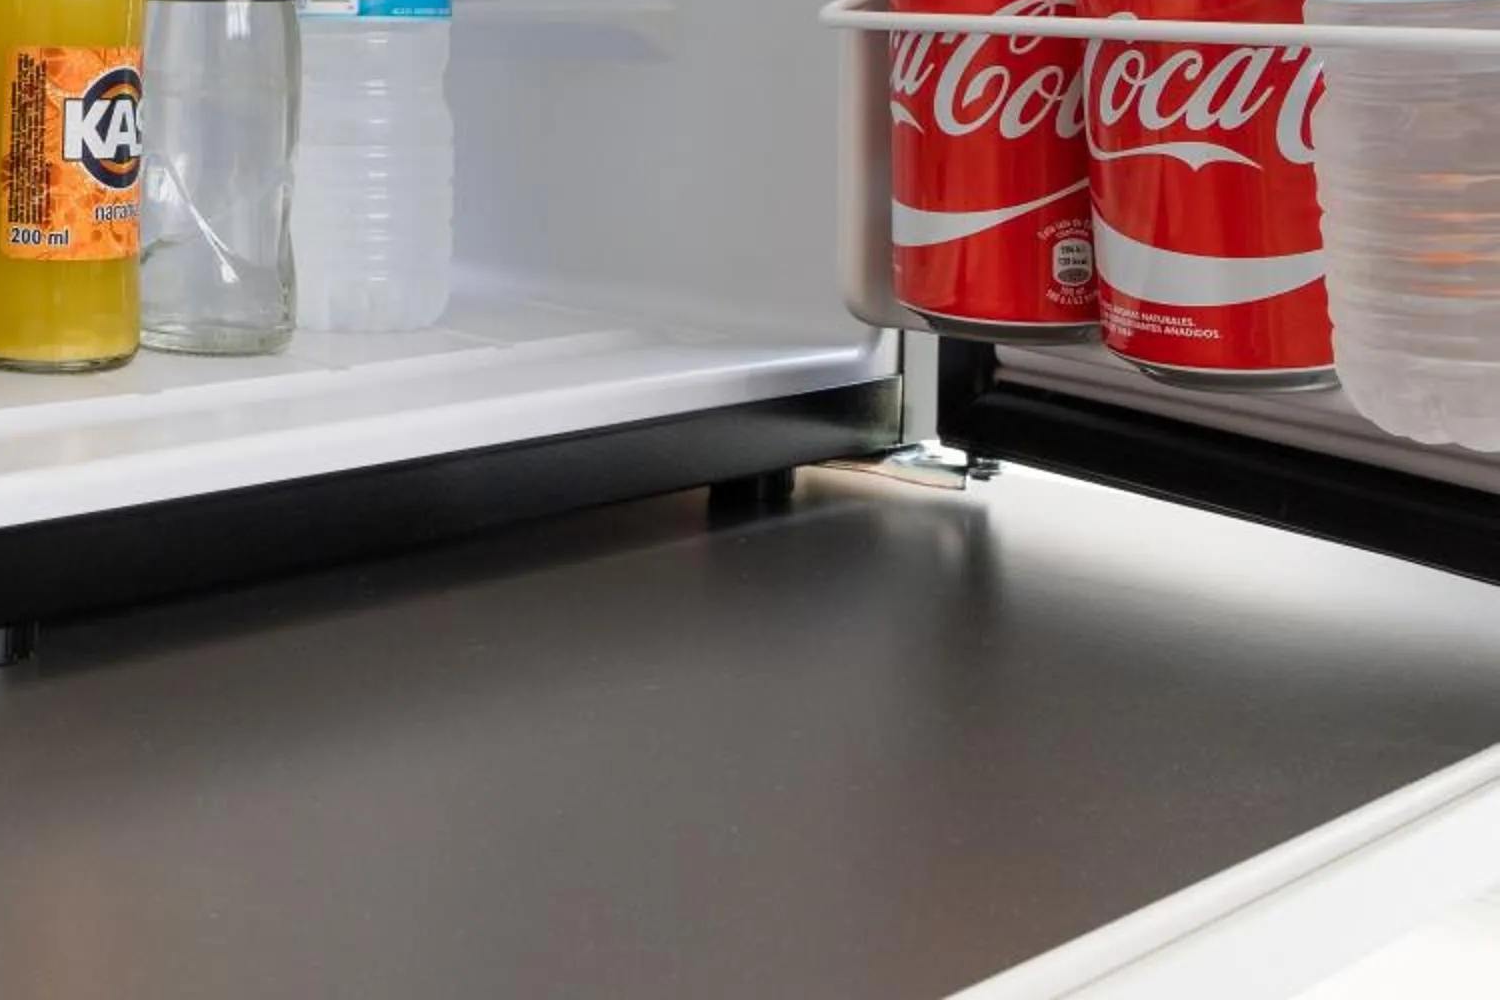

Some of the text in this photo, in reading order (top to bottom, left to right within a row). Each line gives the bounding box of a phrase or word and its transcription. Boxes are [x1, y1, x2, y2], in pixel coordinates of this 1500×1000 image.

[63, 98, 143, 161] KA
[11, 227, 69, 245] 200 ml
